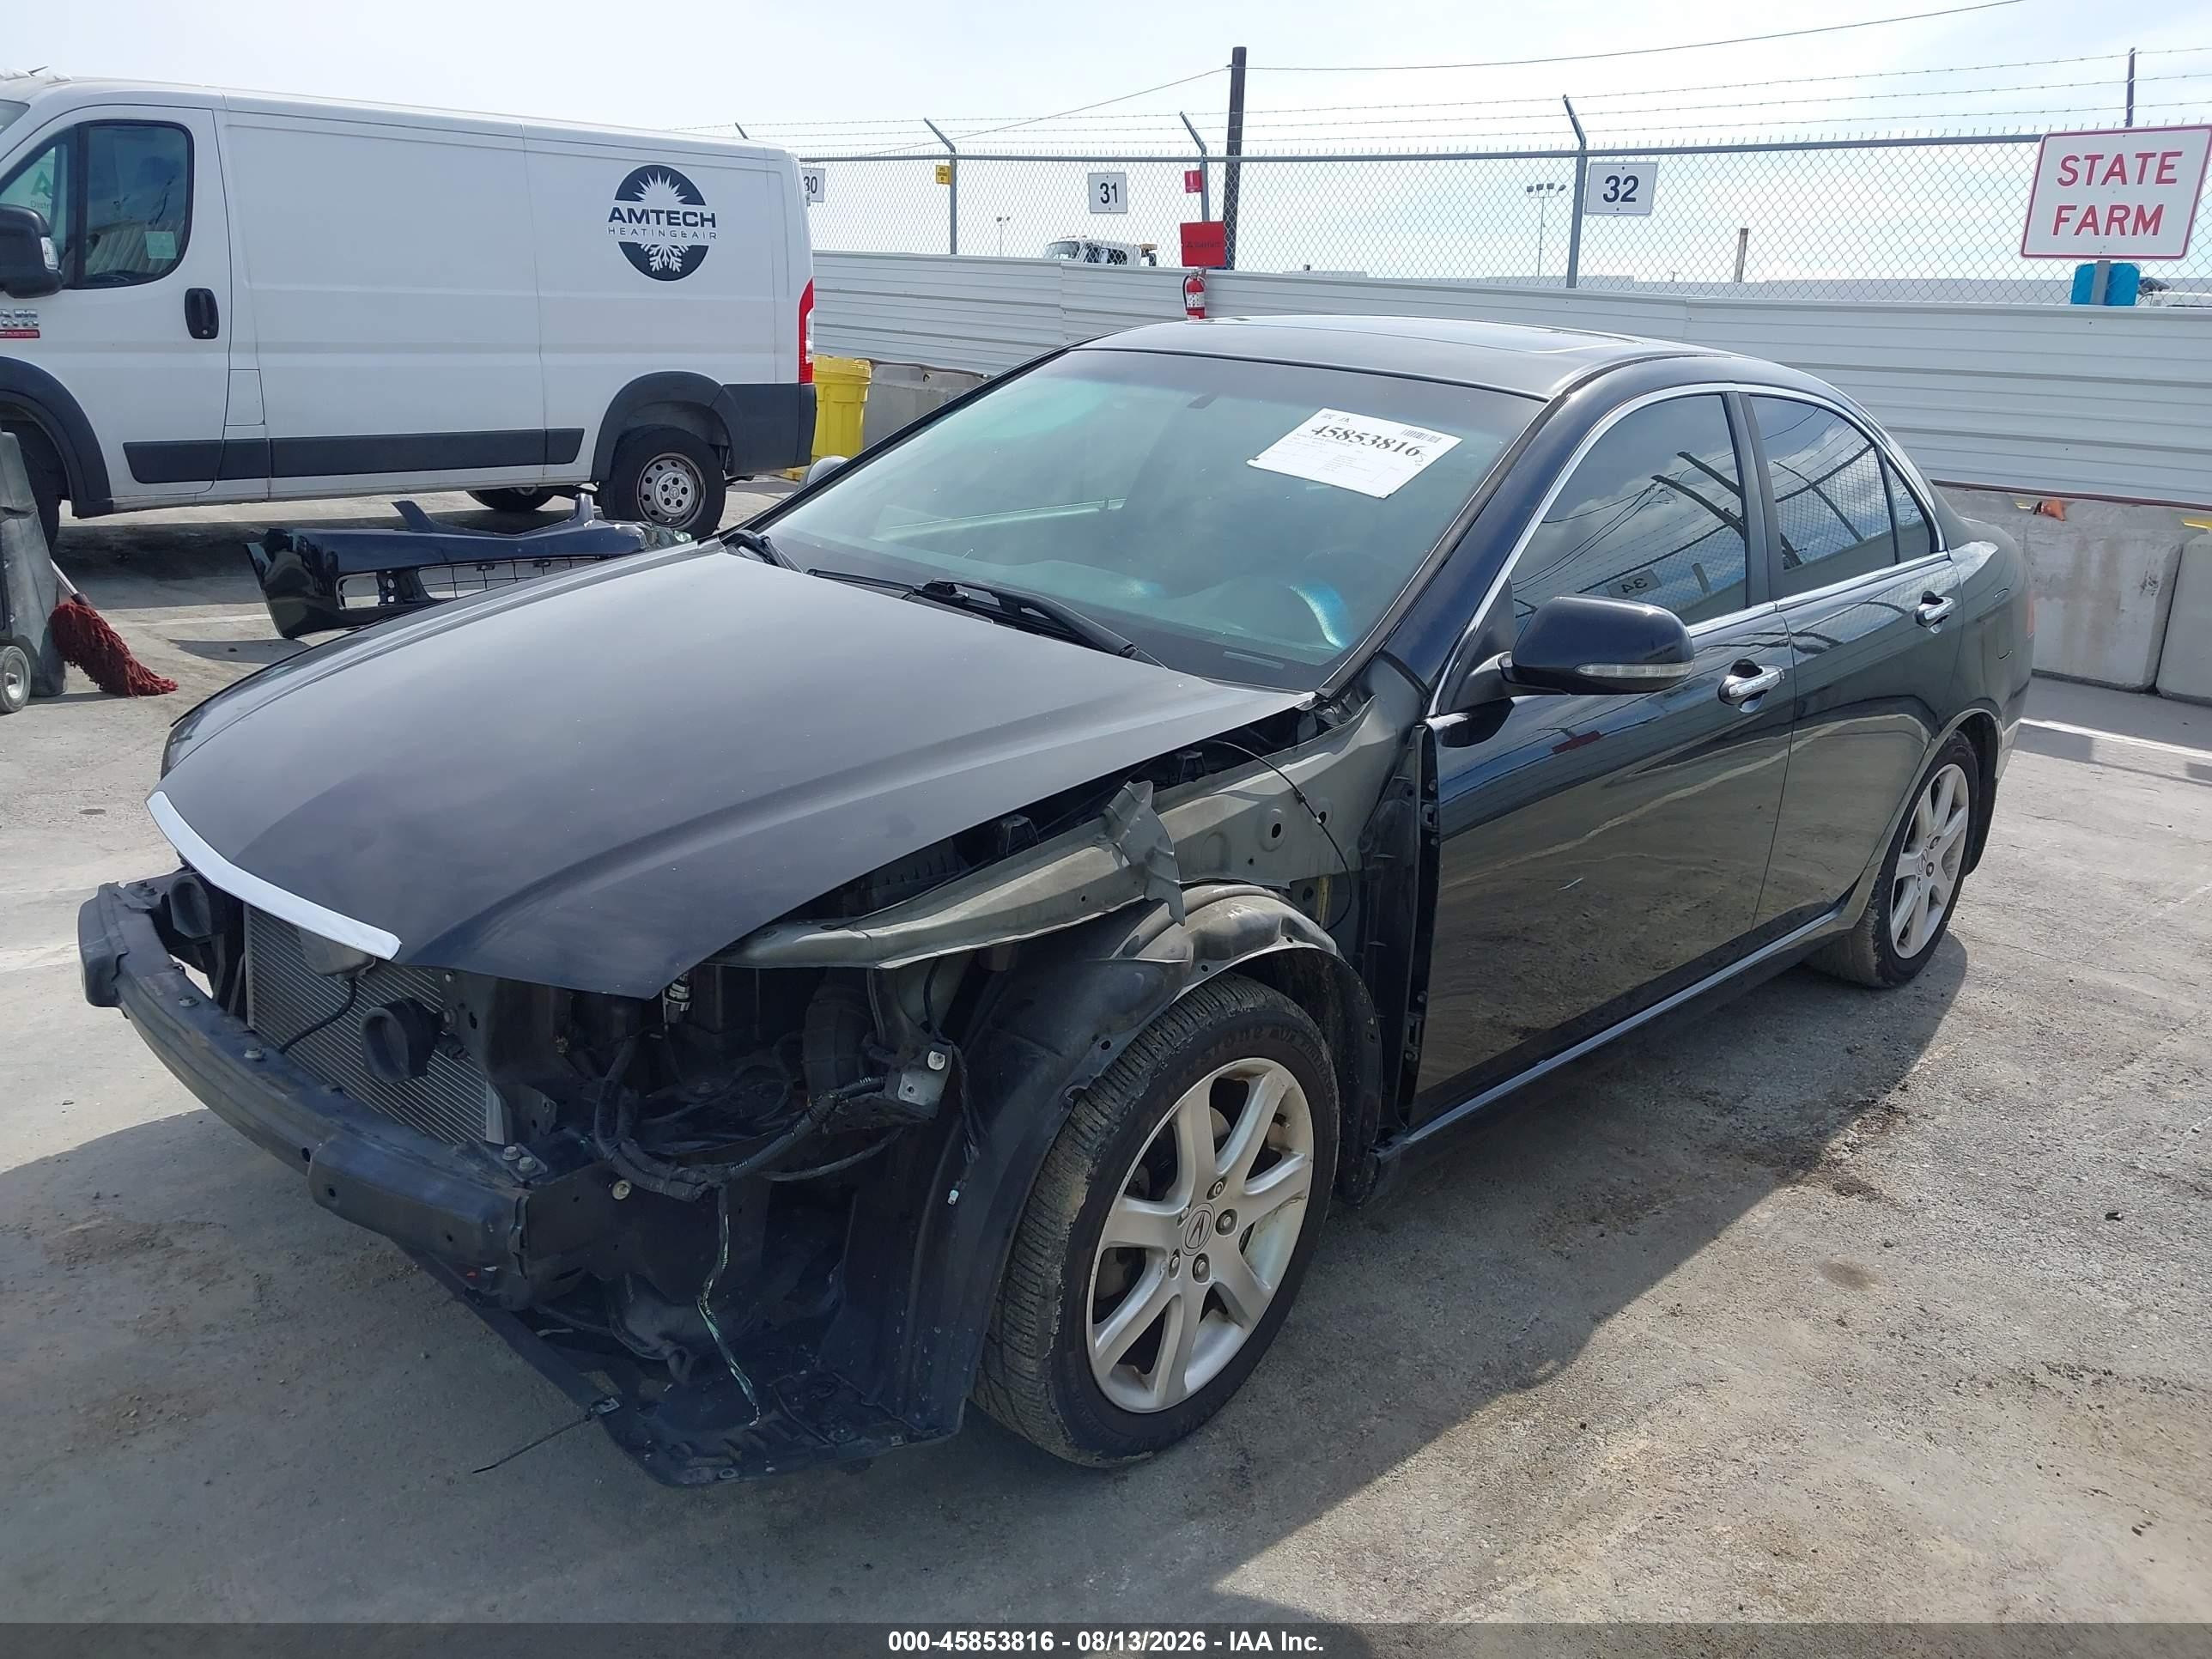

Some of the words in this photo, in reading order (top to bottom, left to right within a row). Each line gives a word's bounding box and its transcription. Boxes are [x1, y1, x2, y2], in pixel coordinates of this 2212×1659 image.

[2057, 151, 2184, 187] STATE
[1100, 182, 1118, 204] 31
[1602, 175, 1639, 203] 32
[608, 207, 717, 228] AMTECH
[2052, 204, 2165, 236] FARM
[1311, 425, 1429, 457] 45853816
